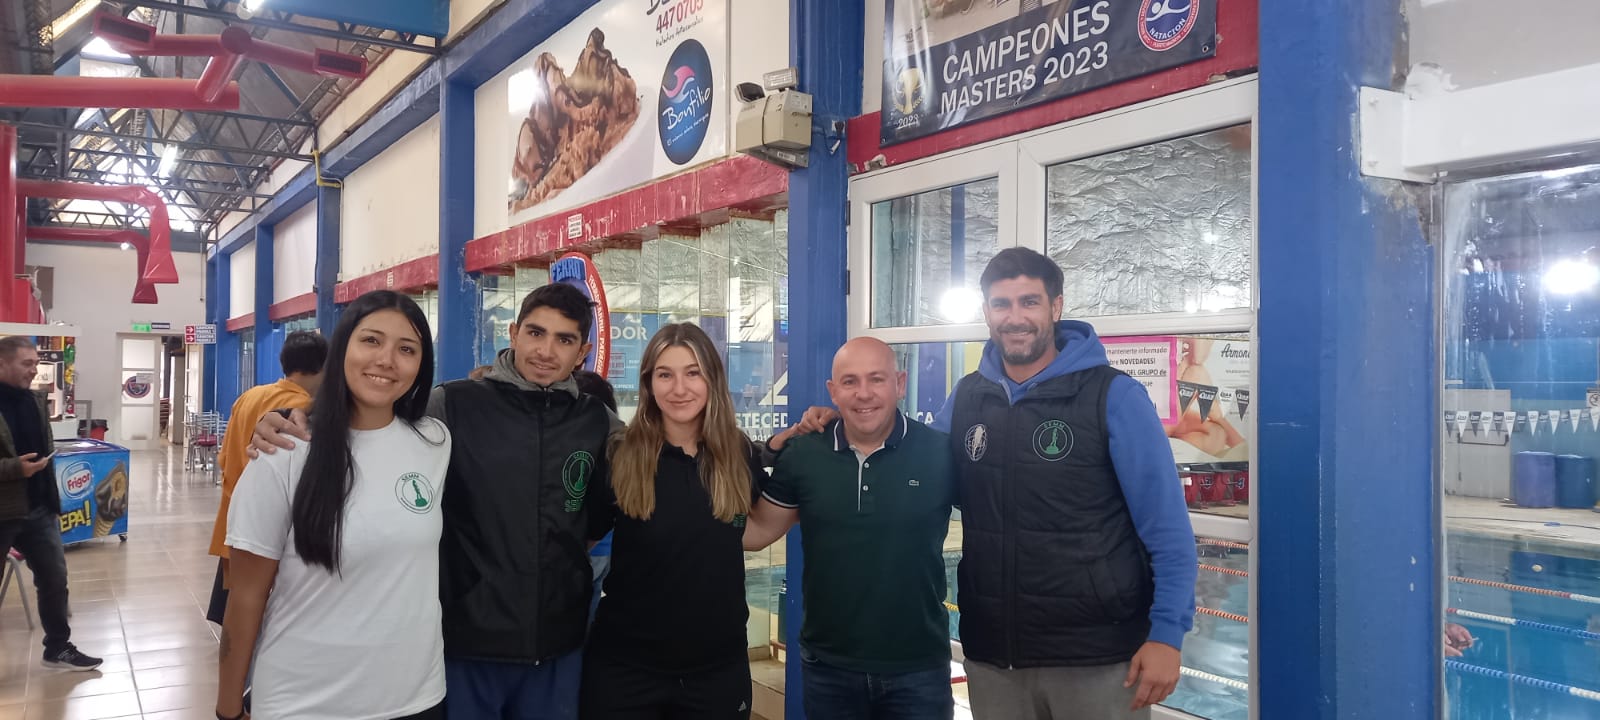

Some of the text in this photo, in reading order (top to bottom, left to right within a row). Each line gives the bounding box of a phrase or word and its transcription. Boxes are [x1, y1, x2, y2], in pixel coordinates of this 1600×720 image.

[1149, 17, 1187, 40] NATACION
[943, 2, 1111, 85] CAMPEONES
[939, 40, 1109, 117] MASTERS 2023
[662, 86, 711, 130] Bonfilio
[551, 259, 583, 281] FERRO
[1138, 346, 1168, 354] informado
[66, 473, 91, 491] Frigor
[59, 500, 92, 533] EPA!
